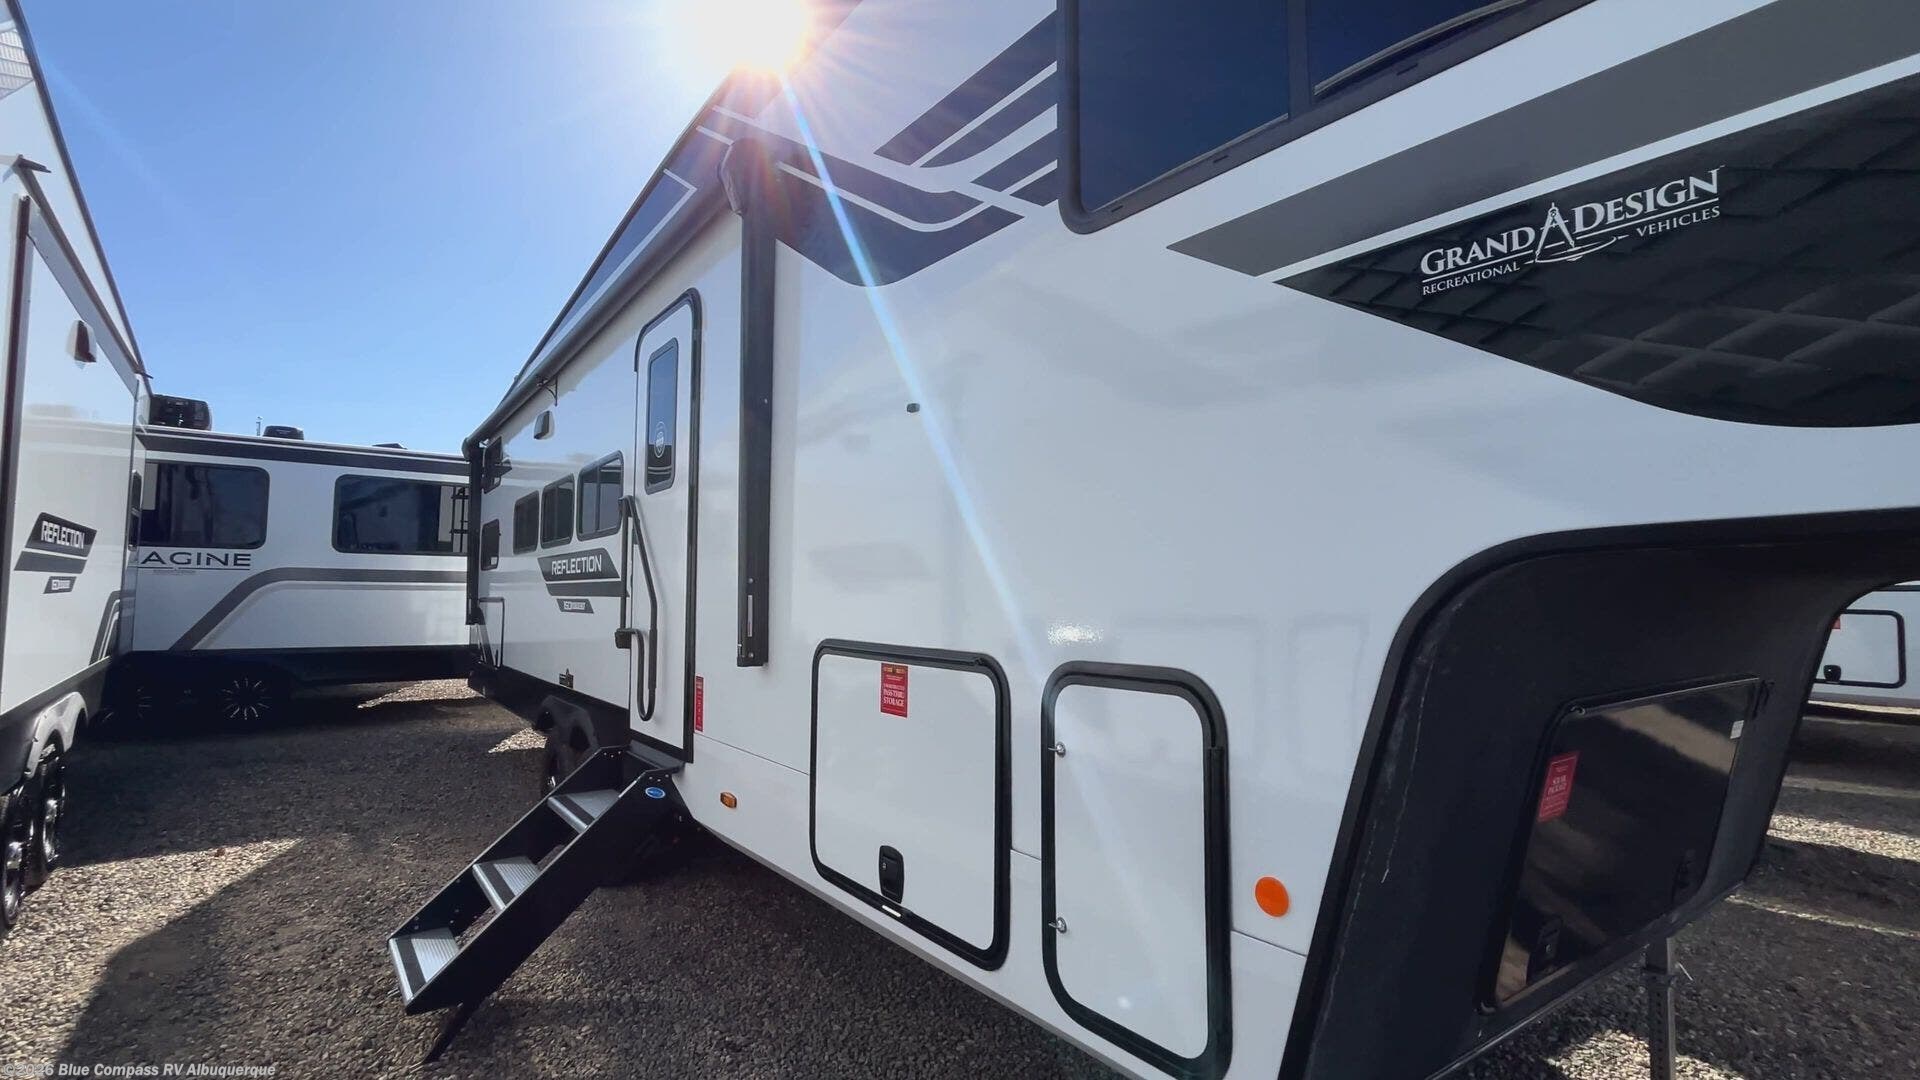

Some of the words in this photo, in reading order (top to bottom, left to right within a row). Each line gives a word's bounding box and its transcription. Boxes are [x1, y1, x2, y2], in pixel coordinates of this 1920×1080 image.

[1420, 226, 1537, 275] GRAND
[1571, 168, 1720, 234] DESIGN
[1422, 262, 1521, 296] RECREATIONAL
[1636, 205, 1720, 238] VEHICLES
[41, 520, 85, 549] REFLECTION
[140, 551, 252, 567] AGINE
[551, 554, 602, 576] REFLECTION
